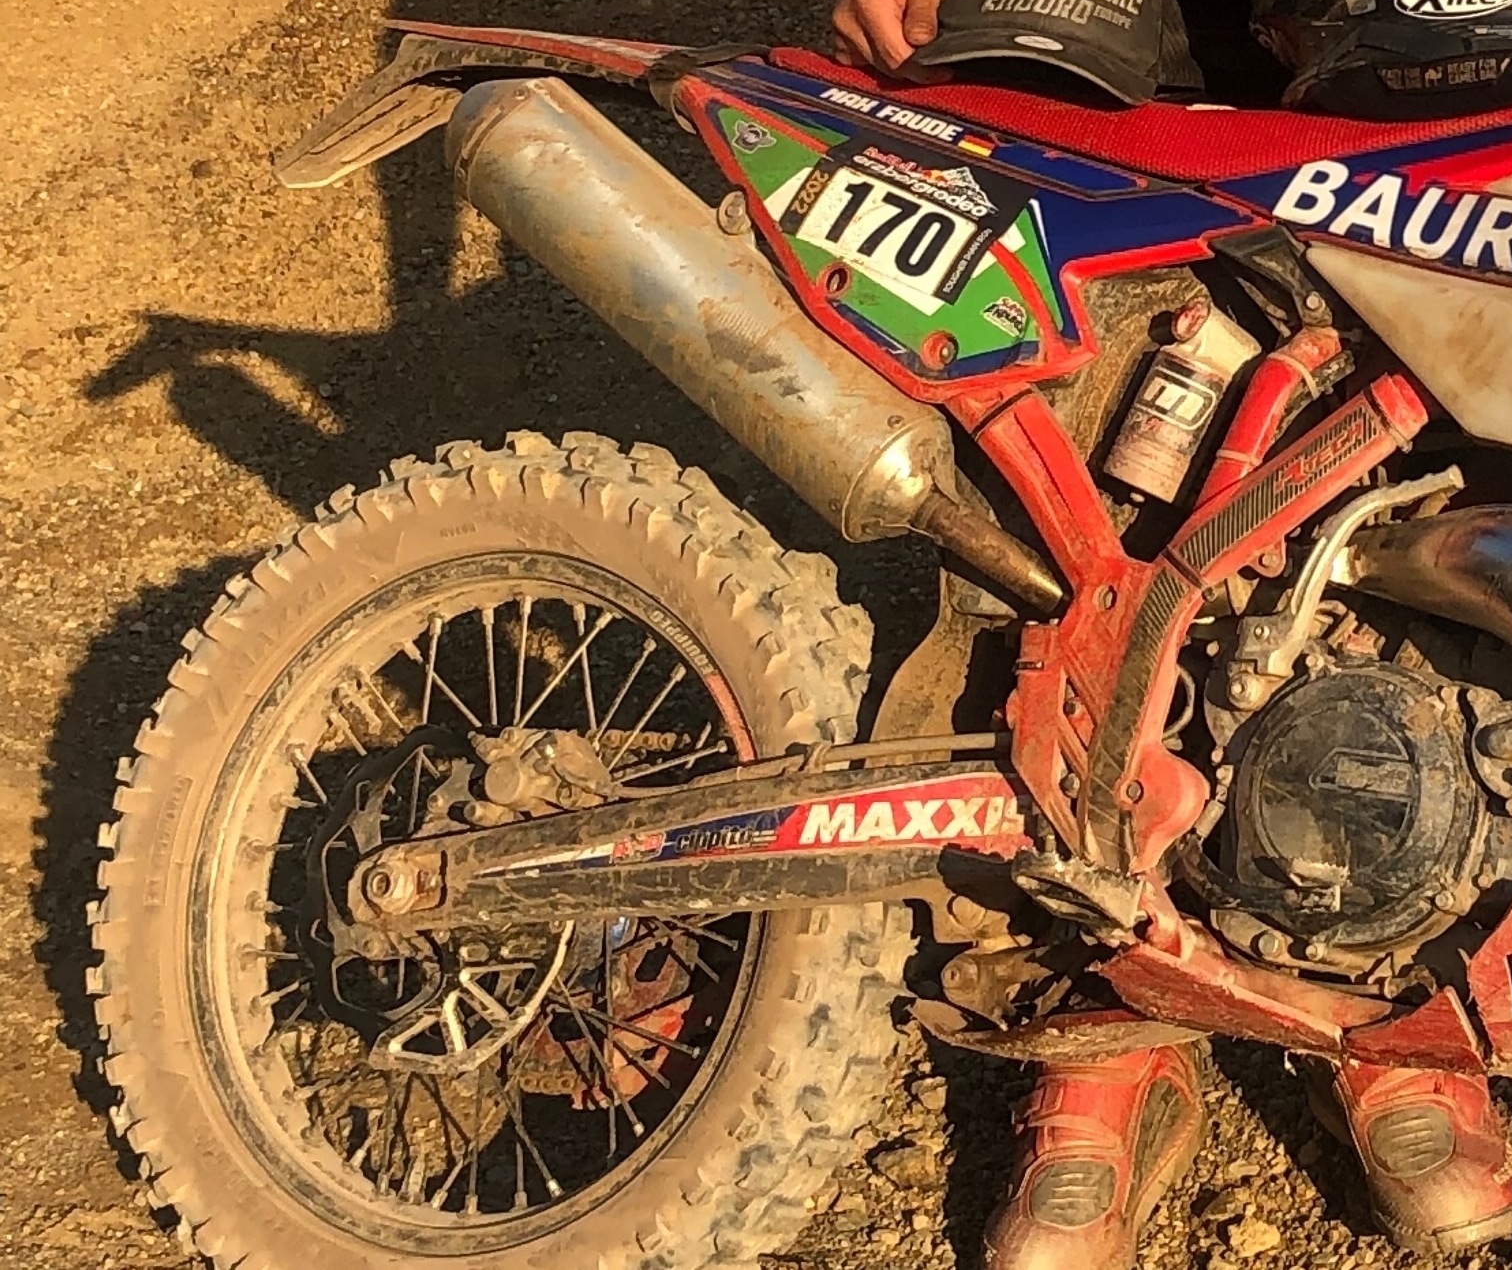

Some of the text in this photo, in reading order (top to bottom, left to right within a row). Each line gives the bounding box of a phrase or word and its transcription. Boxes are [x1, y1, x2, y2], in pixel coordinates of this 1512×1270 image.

[820, 87, 964, 142] MAX FAUDE
[789, 169, 829, 215] 2022
[852, 154, 988, 217] erzbergrodeo
[825, 179, 957, 278] 170
[799, 796, 1026, 846] MAXXIS
